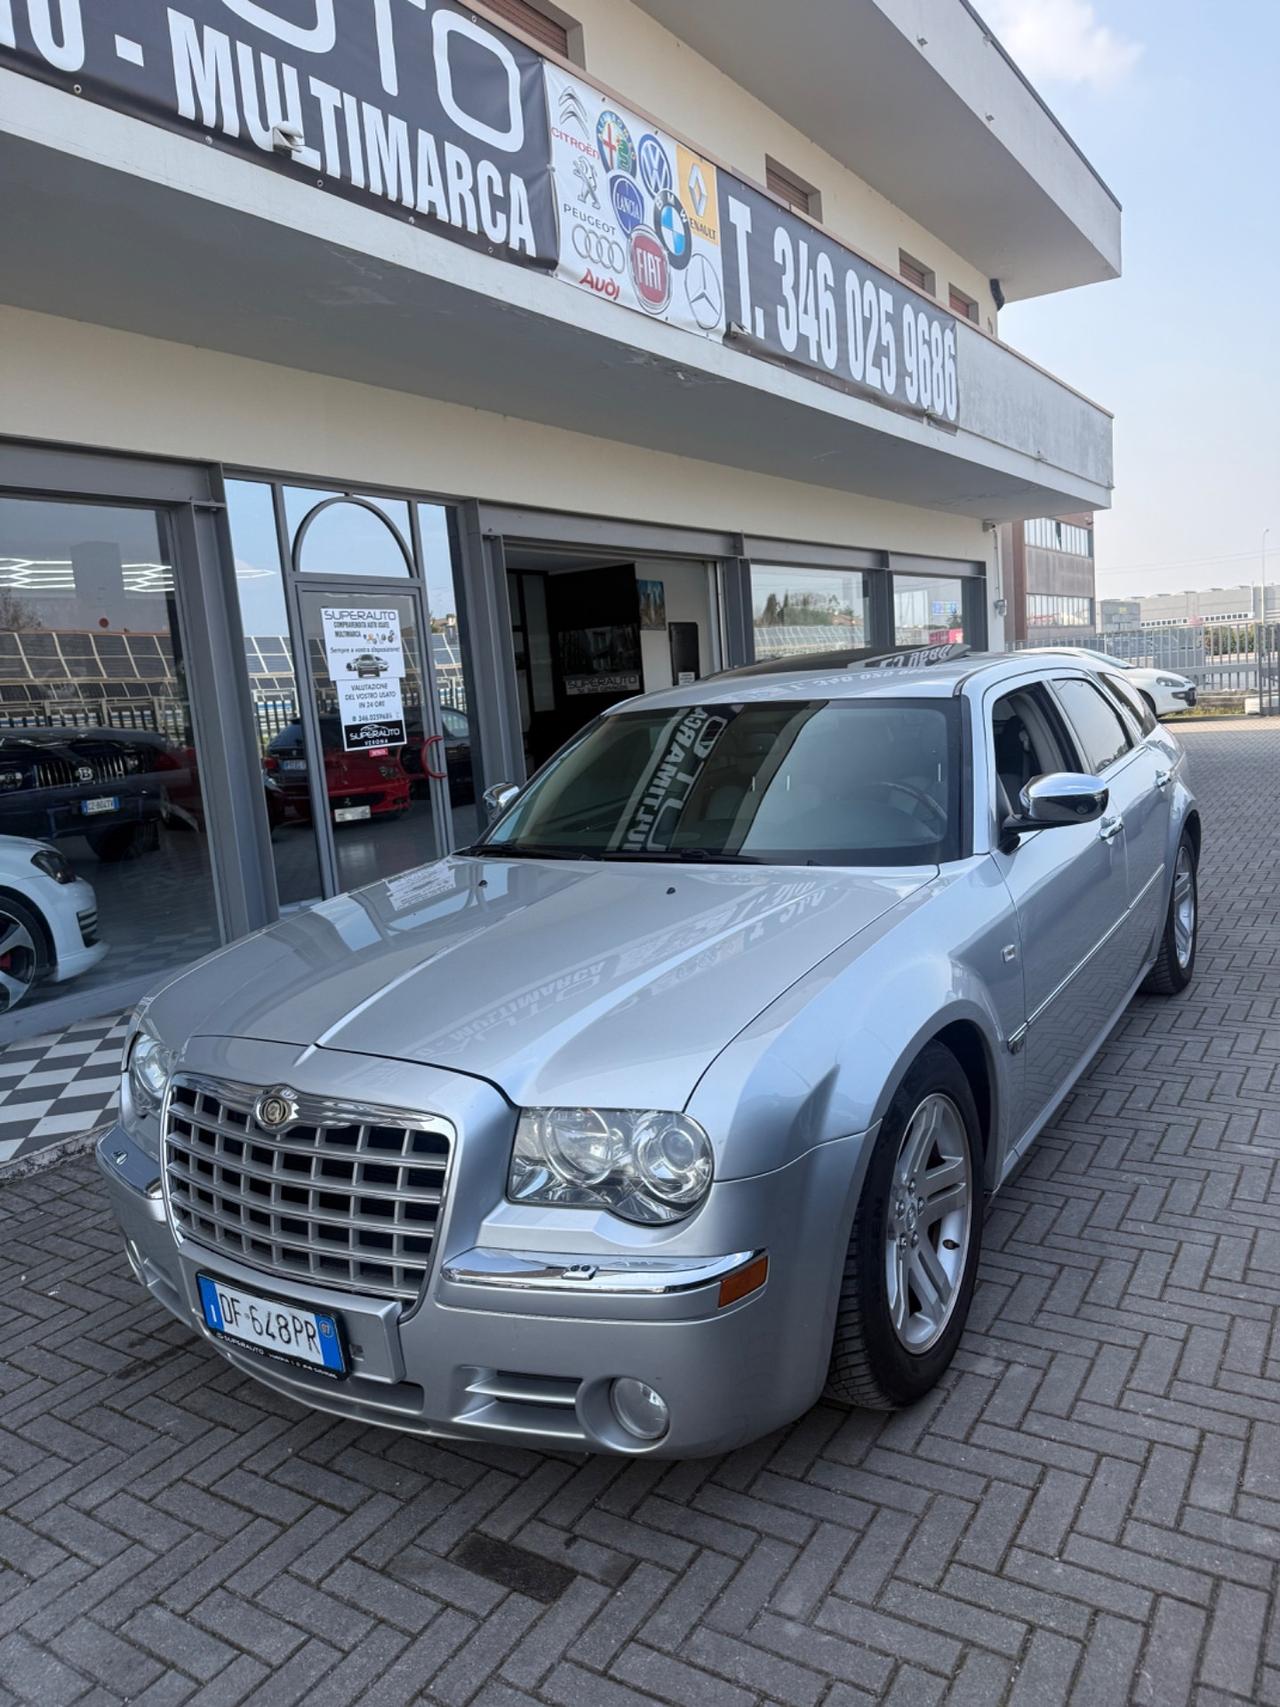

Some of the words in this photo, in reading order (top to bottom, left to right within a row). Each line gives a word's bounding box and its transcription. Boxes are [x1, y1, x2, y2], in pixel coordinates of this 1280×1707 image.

[168, 7, 536, 257] MULTIMARCA
[616, 192, 640, 219] LANCIA
[563, 203, 616, 236] PEUGEOT
[689, 217, 716, 241] ENAULT
[636, 247, 662, 291] FIAT
[728, 195, 764, 339] T.
[774, 227, 837, 370] 346
[846, 269, 896, 395] 025
[902, 304, 956, 421] 9686
[324, 610, 396, 621] SUPERAUTO
[351, 682, 388, 692] VALUTAZIONE
[356, 691, 378, 700] VOSTRO
[379, 691, 396, 699] USATO
[349, 728, 400, 741] SUPERAUTO
[219, 1293, 241, 1328] DF
[249, 1305, 321, 1354] 648PR
